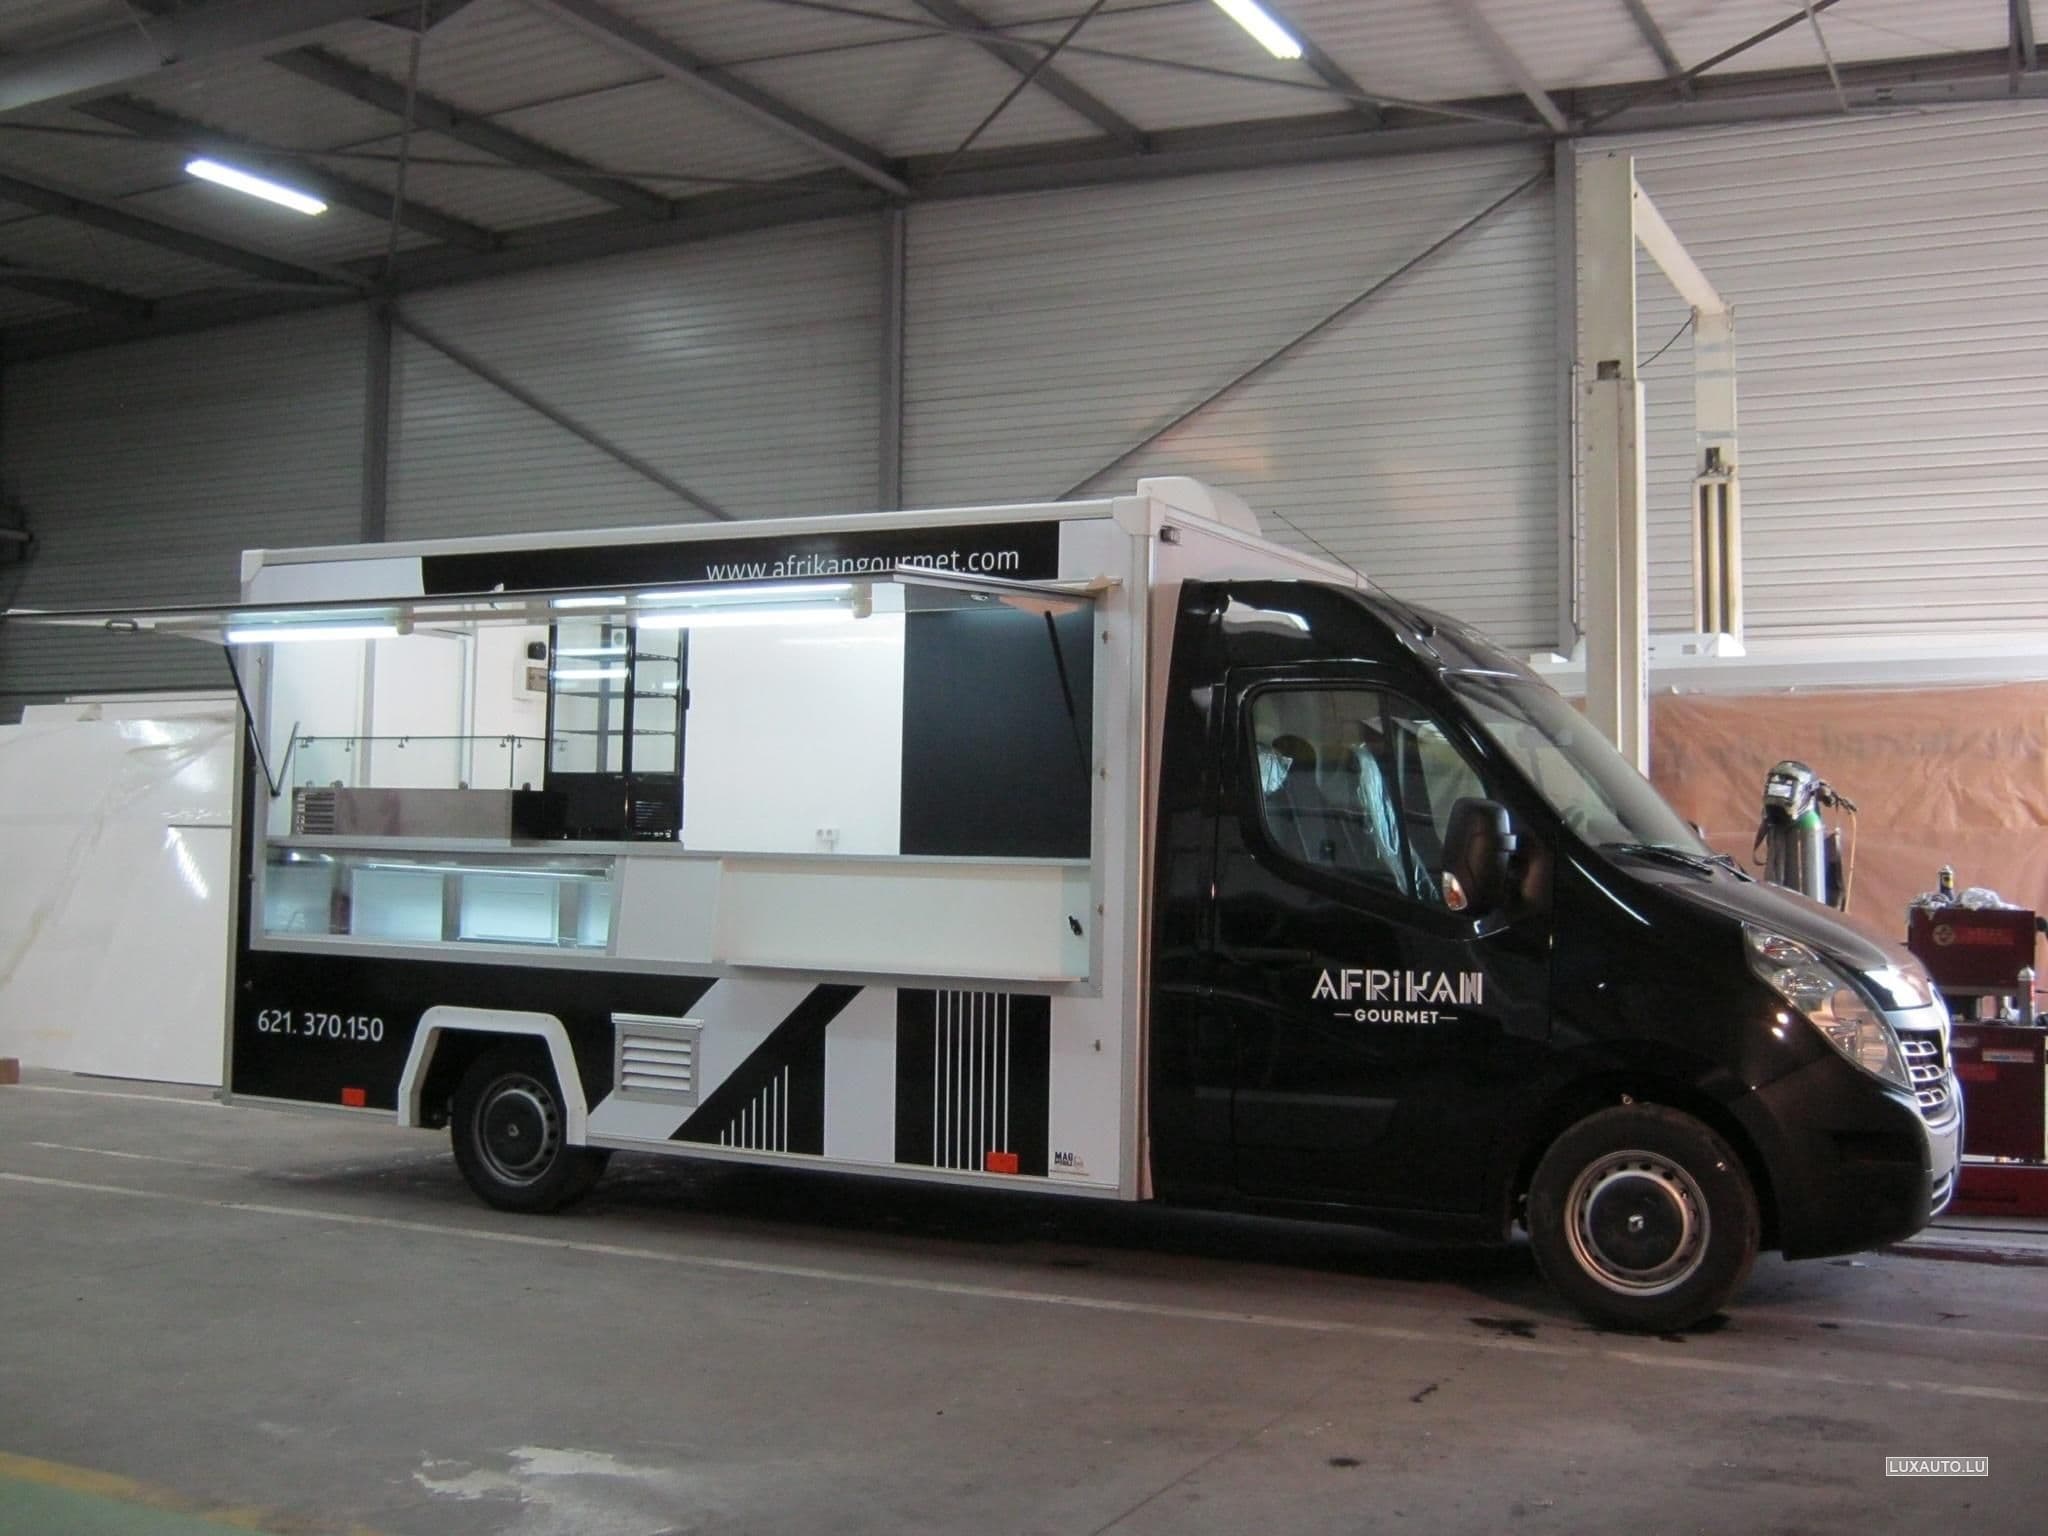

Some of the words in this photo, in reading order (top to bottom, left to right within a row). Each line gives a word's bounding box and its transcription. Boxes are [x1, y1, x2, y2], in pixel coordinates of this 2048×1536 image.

[706, 550, 1019, 580] wwwafrikangourmet.com
[257, 1009, 297, 1034] 621.
[303, 1012, 384, 1042] 370.150
[1354, 1008, 1439, 1025] GOURMET
